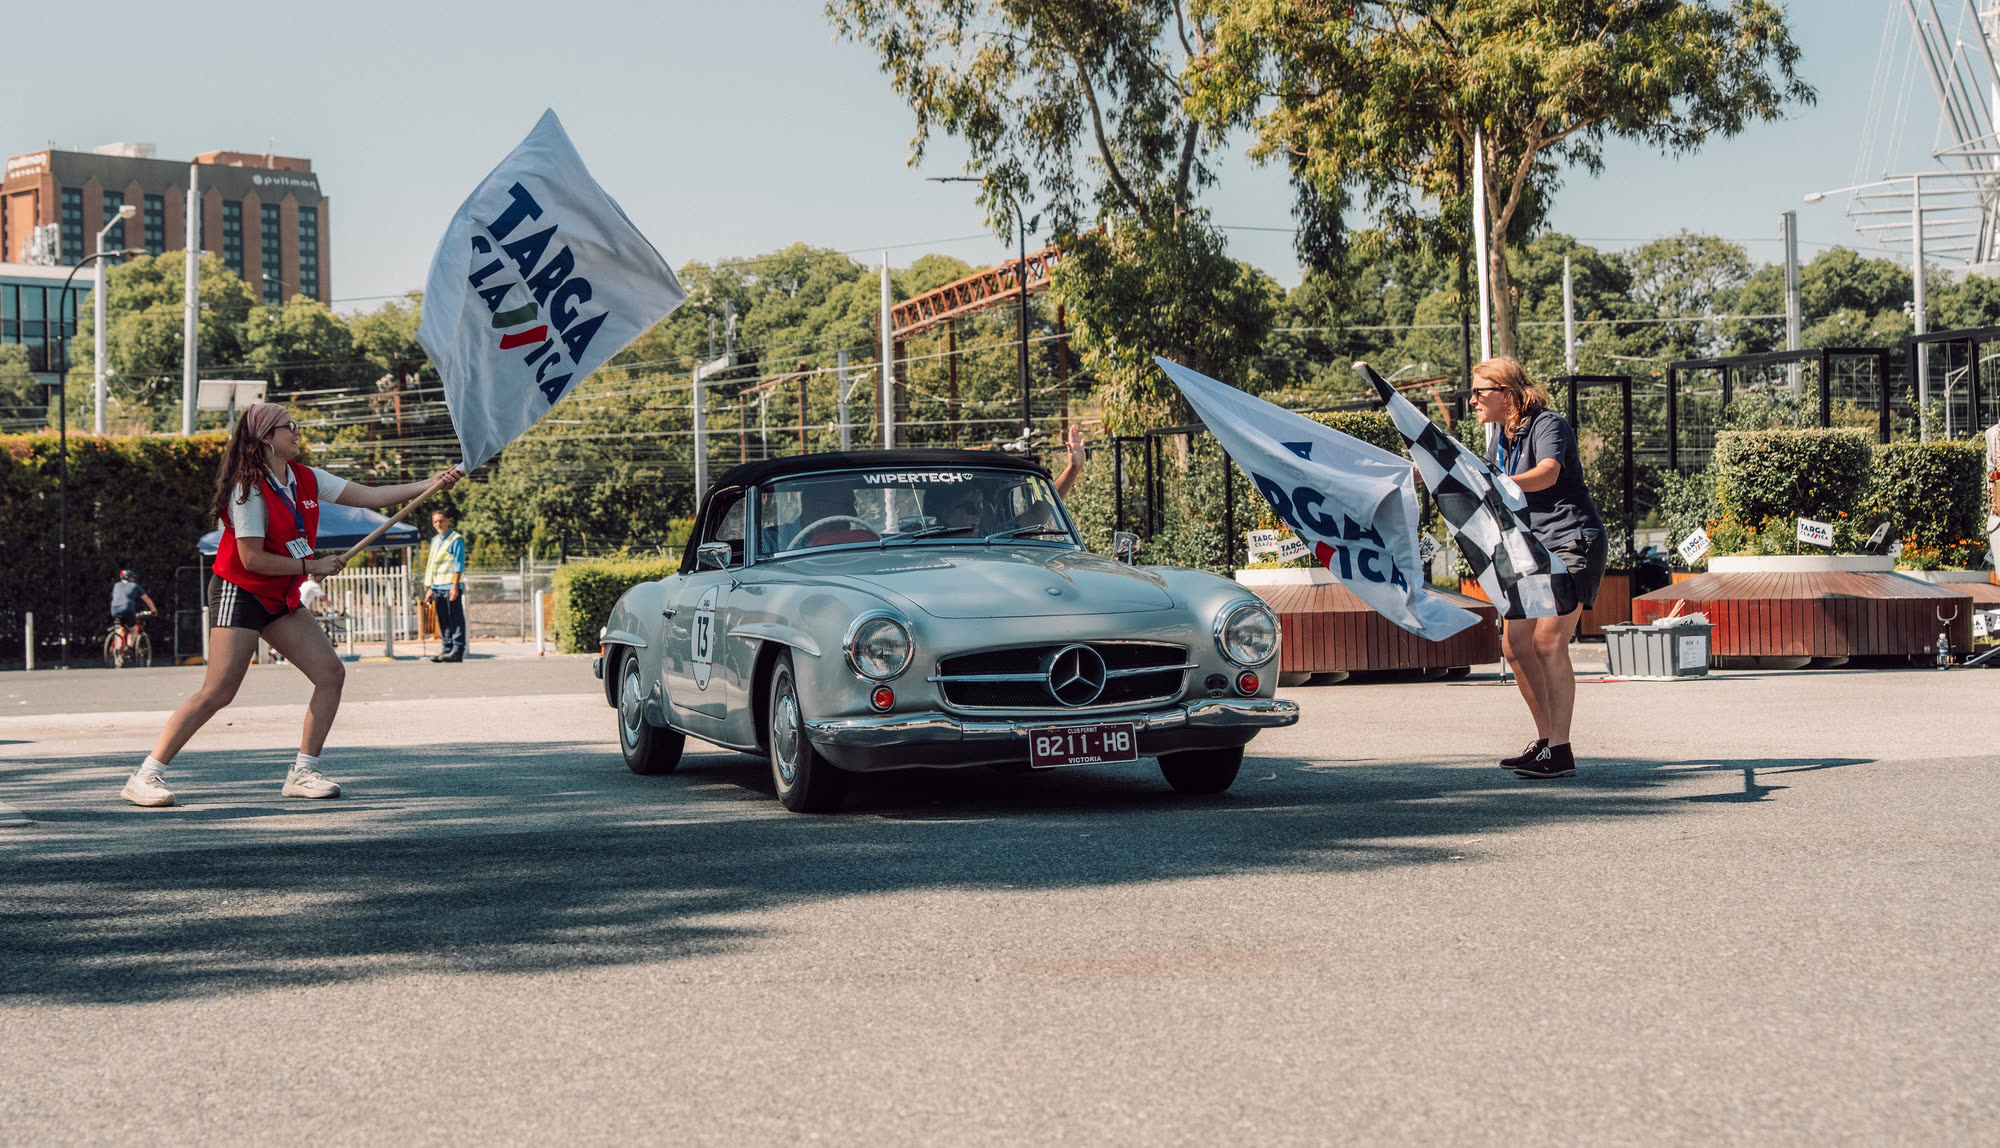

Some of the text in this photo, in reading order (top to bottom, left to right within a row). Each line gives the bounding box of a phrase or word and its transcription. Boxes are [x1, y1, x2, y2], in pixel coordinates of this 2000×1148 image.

[264, 176, 318, 191] pullman
[487, 181, 610, 365] TARGA
[863, 472, 963, 484] WIPERTECH
[1800, 523, 1826, 535] TARGA
[1683, 535, 1703, 553] TARGA
[697, 616, 709, 658] 13
[1068, 755, 1102, 764] VICTORIA
